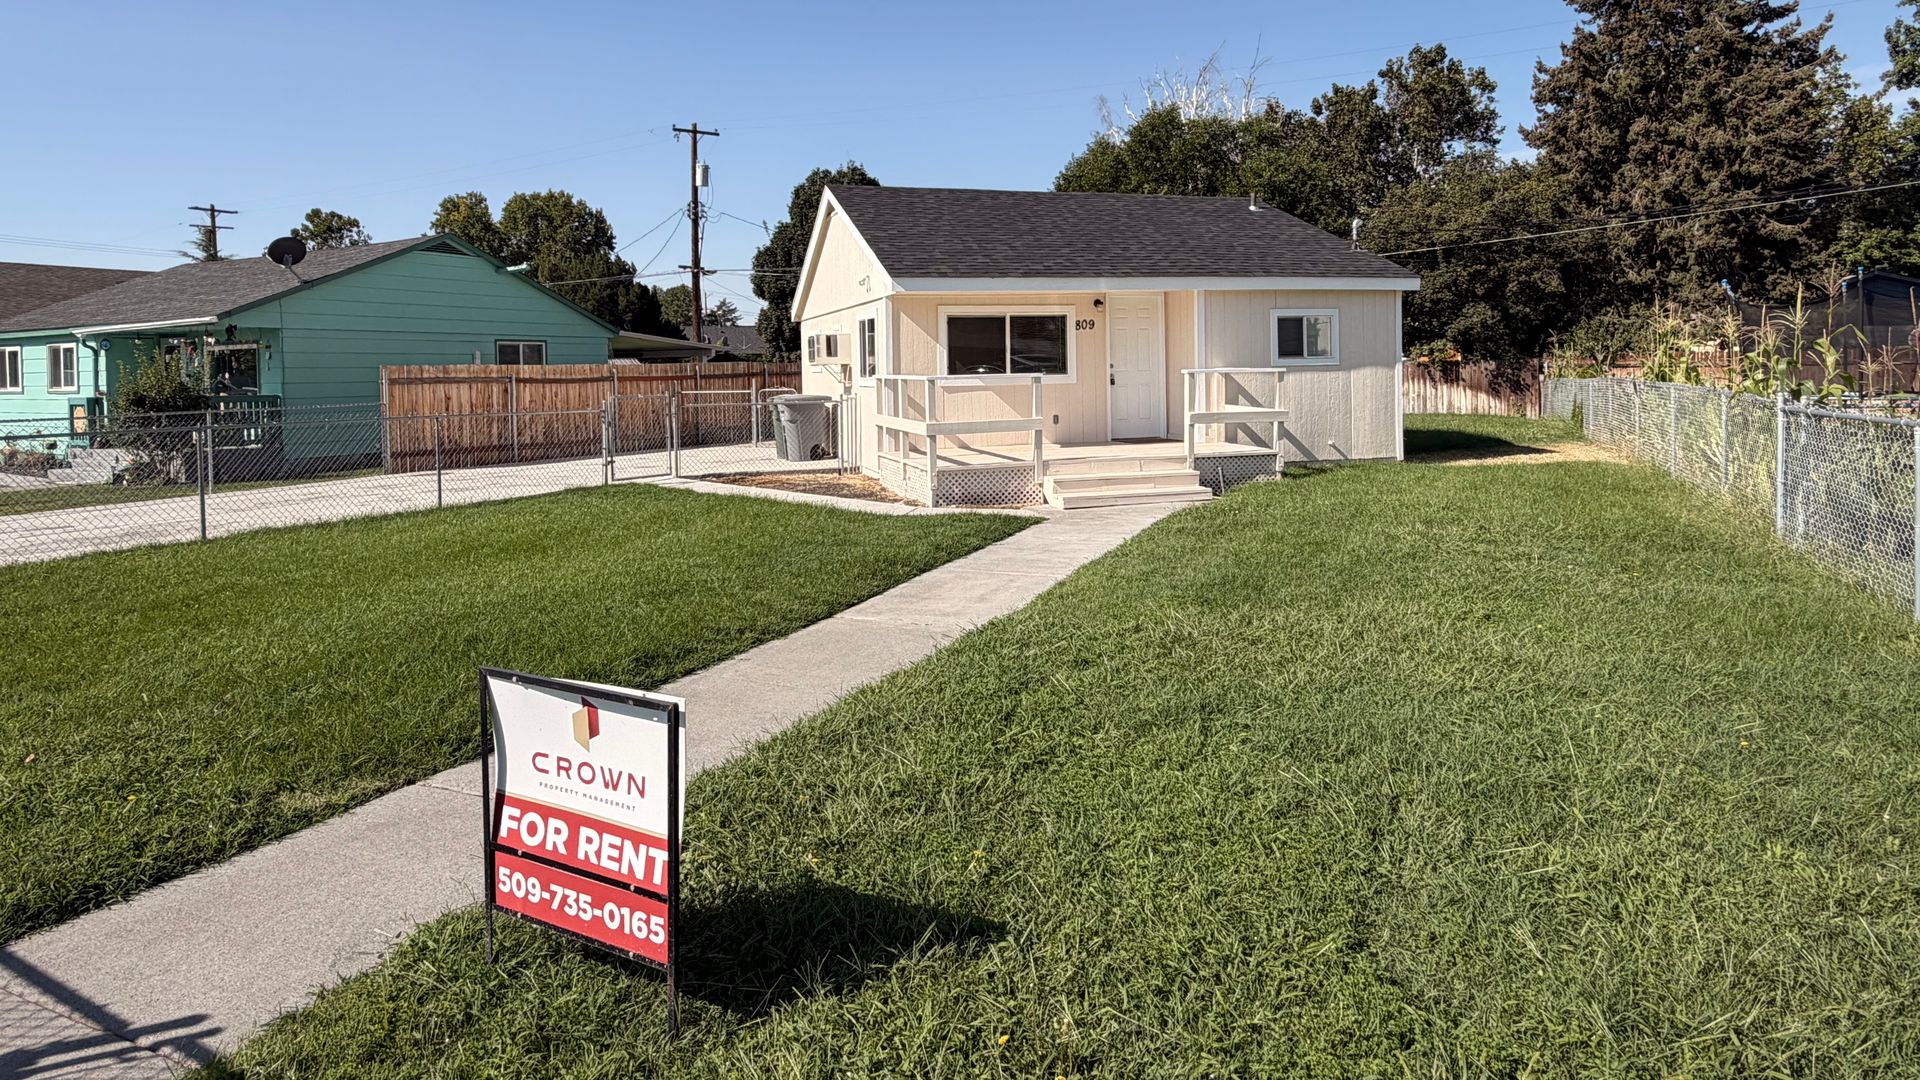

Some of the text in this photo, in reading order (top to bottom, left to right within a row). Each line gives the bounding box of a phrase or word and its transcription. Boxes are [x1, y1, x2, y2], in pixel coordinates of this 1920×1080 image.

[1075, 319, 1095, 331] 809
[532, 752, 645, 799] CROWN
[539, 782, 636, 812] PROPERTY MANAGEMENT
[500, 804, 669, 886] FOR RENT
[498, 866, 665, 945] 509-735-0165
